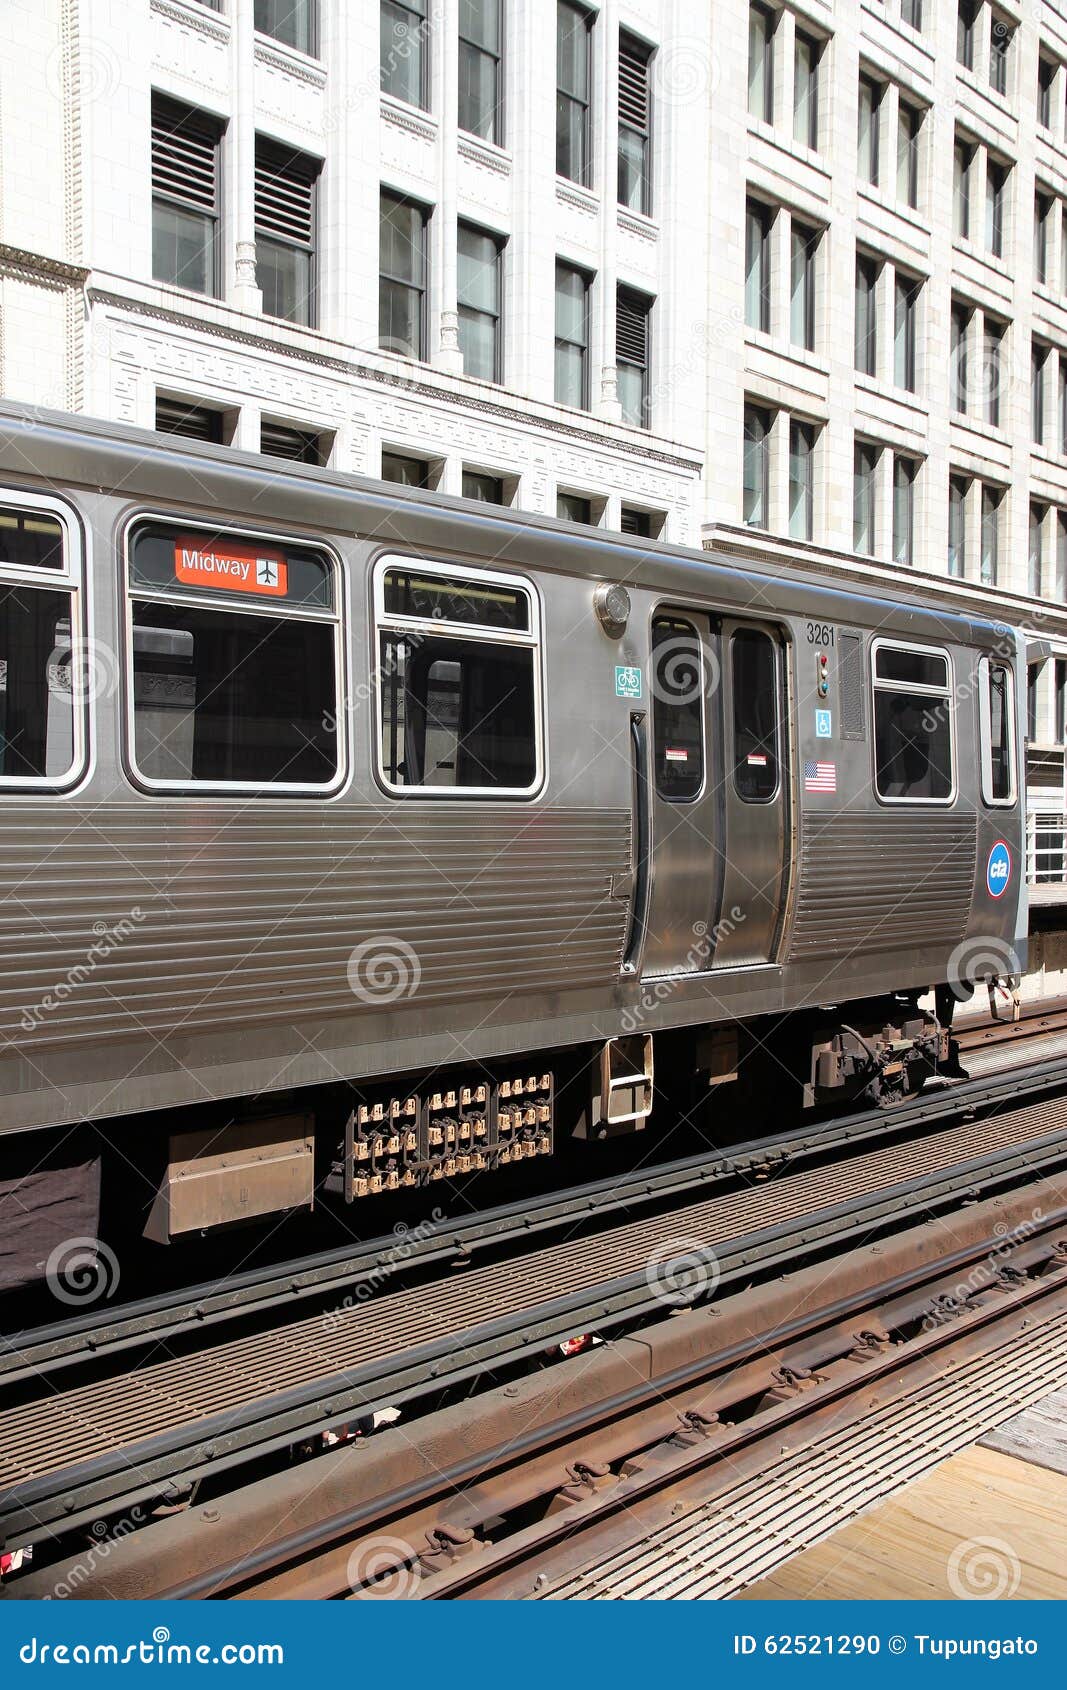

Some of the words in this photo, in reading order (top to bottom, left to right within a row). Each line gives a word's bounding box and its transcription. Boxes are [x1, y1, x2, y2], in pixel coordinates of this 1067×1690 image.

[182, 549, 250, 580] Midway
[806, 622, 834, 647] 3261
[990, 860, 1007, 878] cta
